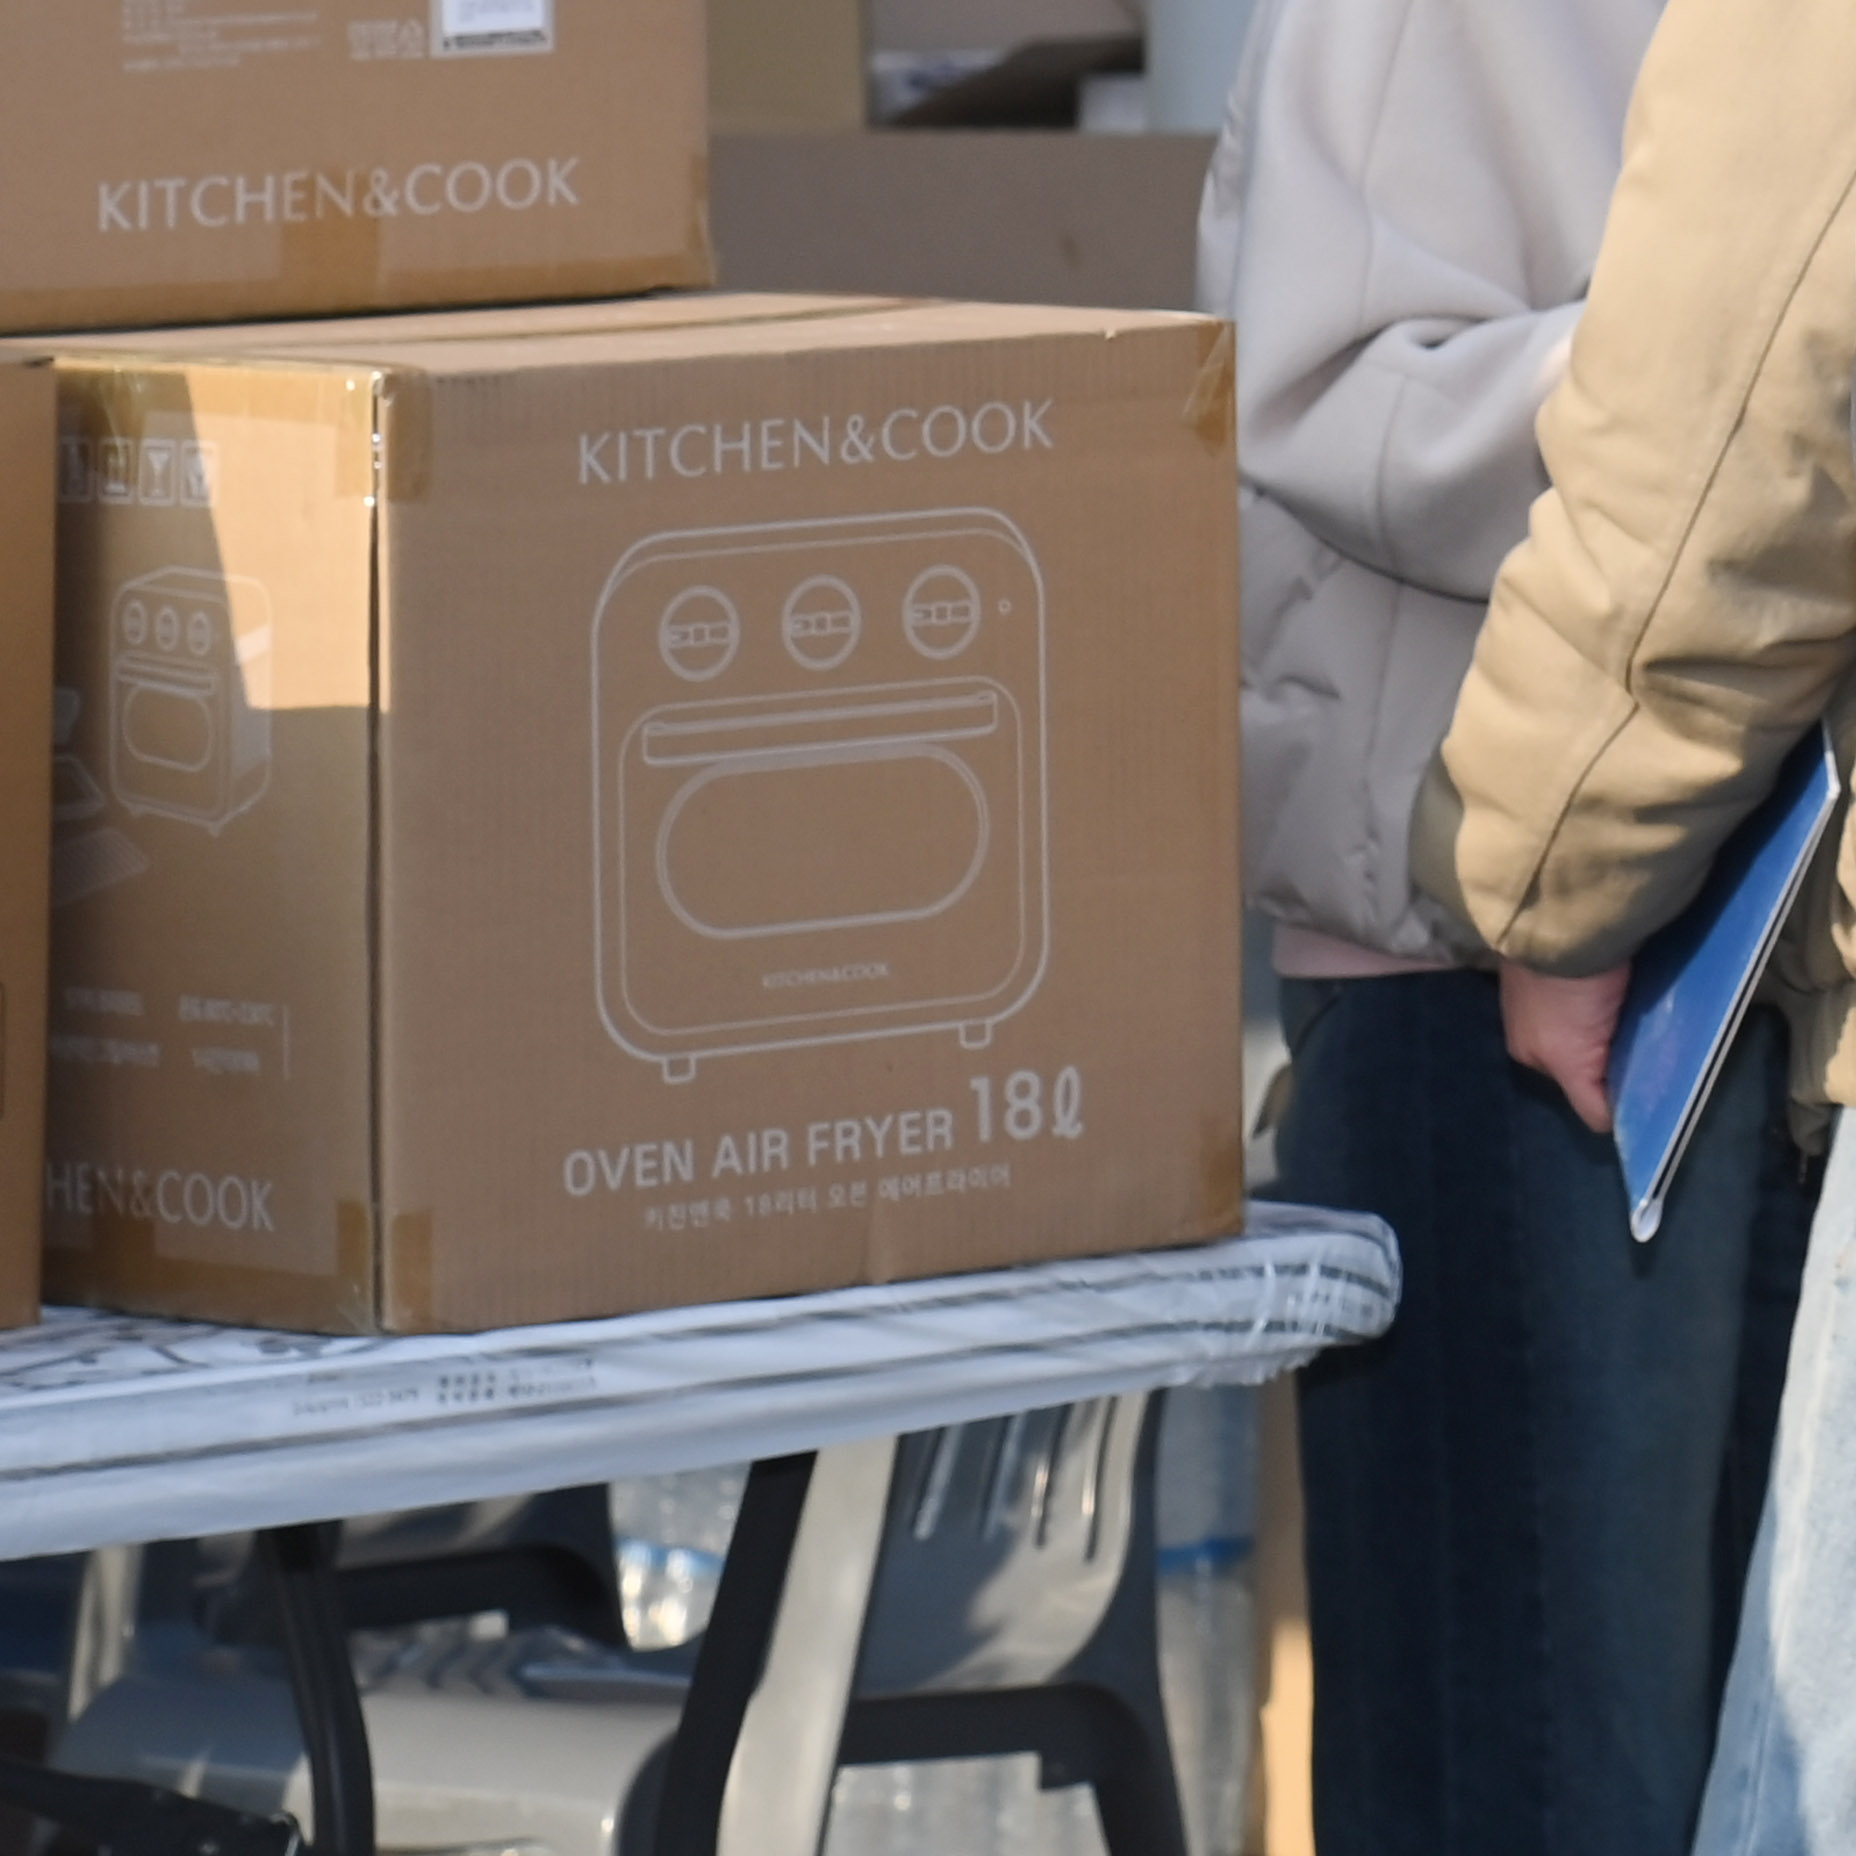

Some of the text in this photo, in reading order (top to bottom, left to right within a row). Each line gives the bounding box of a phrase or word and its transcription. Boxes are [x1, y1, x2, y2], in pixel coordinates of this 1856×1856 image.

[98, 156, 580, 232] KITCHEN&COOK
[577, 397, 1055, 485] KITCHEN&COOK
[563, 1137, 695, 1197] OVEN
[711, 1127, 791, 1178] AIR
[806, 1107, 955, 1166] FRYER
[46, 1161, 275, 1232] HEN&COOK
